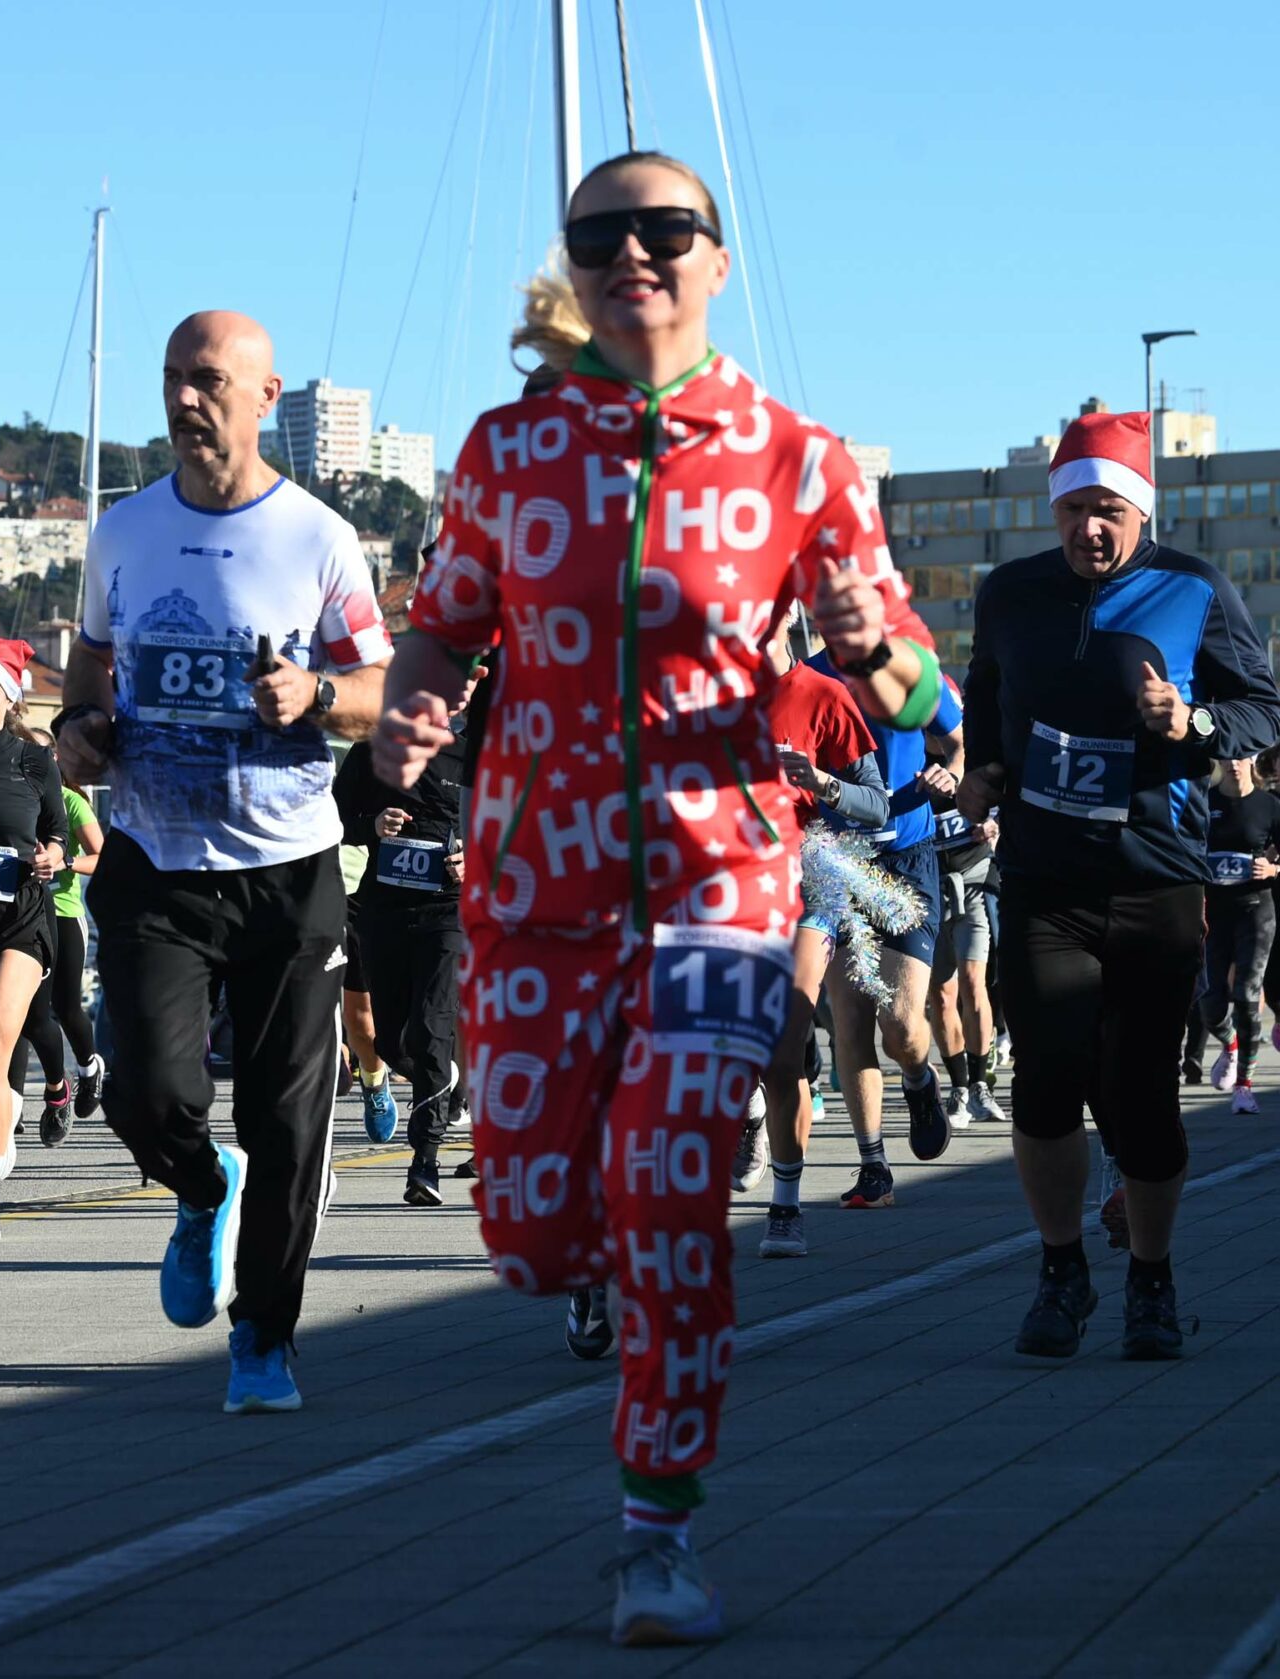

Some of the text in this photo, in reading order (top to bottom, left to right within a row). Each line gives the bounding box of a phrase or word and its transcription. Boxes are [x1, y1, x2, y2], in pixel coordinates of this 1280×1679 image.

[488, 416, 569, 474] HO
[665, 487, 771, 552] HO
[150, 635, 245, 649] TORPEDO RUNNERS
[508, 604, 591, 667] HO
[160, 652, 225, 697] 83
[662, 667, 745, 736] HO
[501, 700, 555, 756] HO
[1080, 740, 1125, 750] RUNNERS
[1051, 750, 1106, 793] 12
[392, 849, 430, 875] 40
[538, 791, 632, 878] HO
[1216, 857, 1243, 875] 43
[476, 966, 549, 1026] HO
[671, 951, 786, 1035] 114
[665, 1050, 752, 1120] HO
[483, 1153, 570, 1222] HO
[624, 1128, 710, 1196] HO
[626, 1230, 715, 1293] HO
[665, 1326, 735, 1398] HO
[624, 1402, 706, 1469] HO
